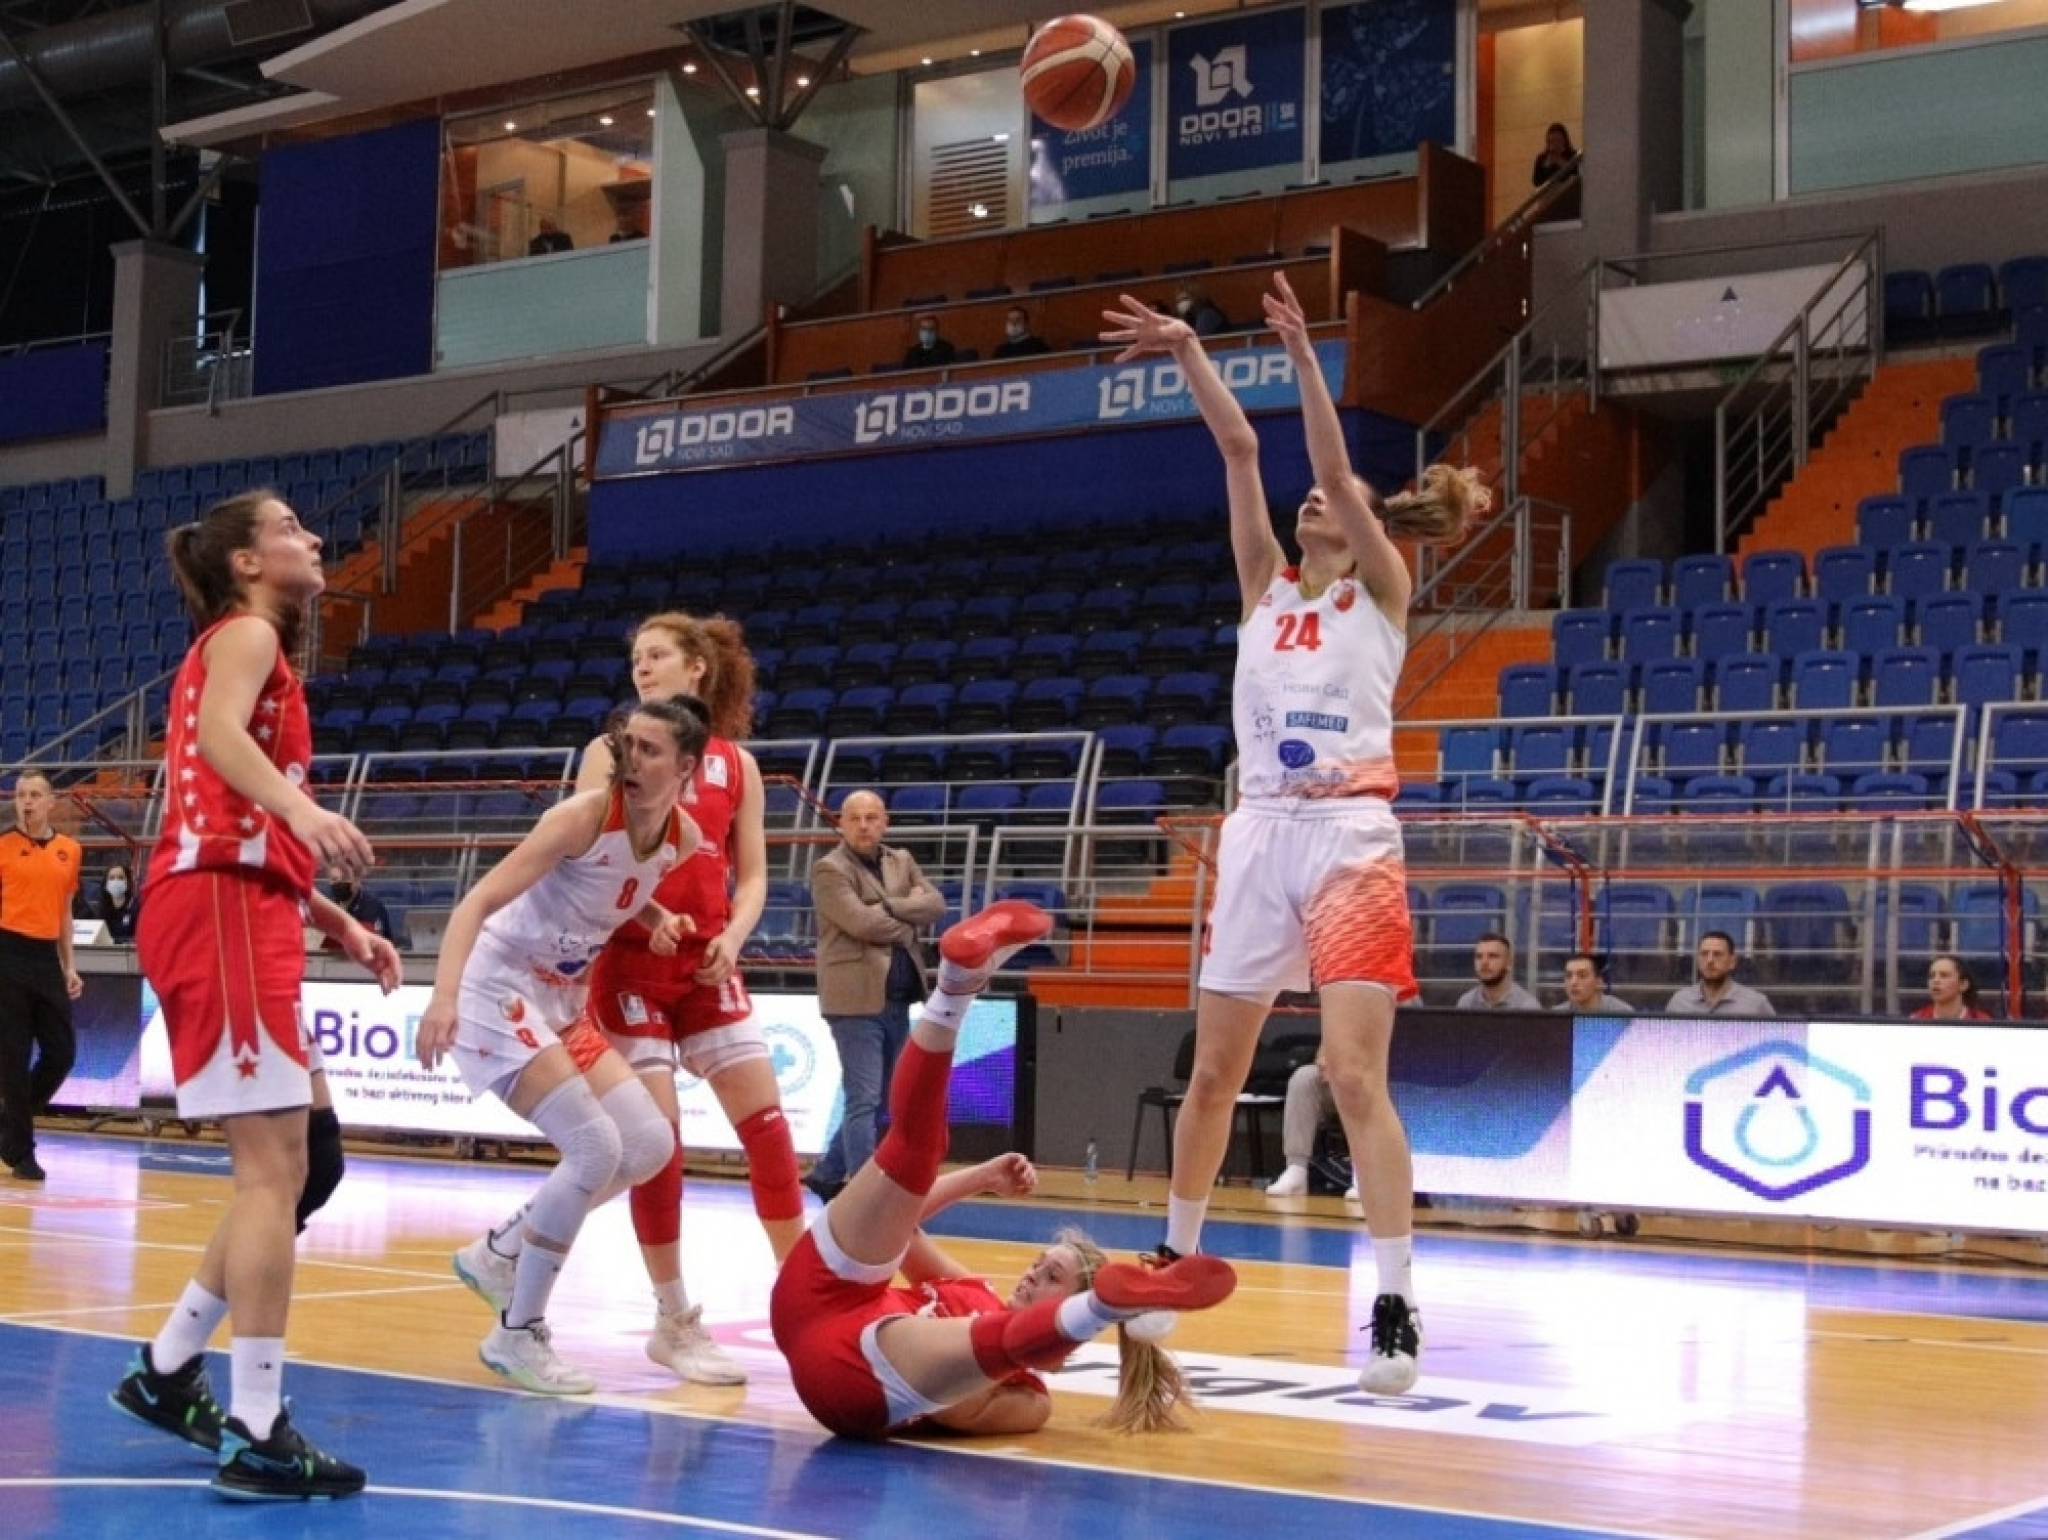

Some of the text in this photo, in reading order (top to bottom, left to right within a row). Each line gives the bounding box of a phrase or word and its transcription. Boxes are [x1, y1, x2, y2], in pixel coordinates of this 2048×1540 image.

[1178, 131, 1222, 145] NOVI
[1180, 104, 1262, 135] DDOR
[903, 380, 1031, 422] DDOR
[679, 404, 794, 446] DDOR
[1273, 611, 1323, 652] 24
[616, 876, 640, 910] 8
